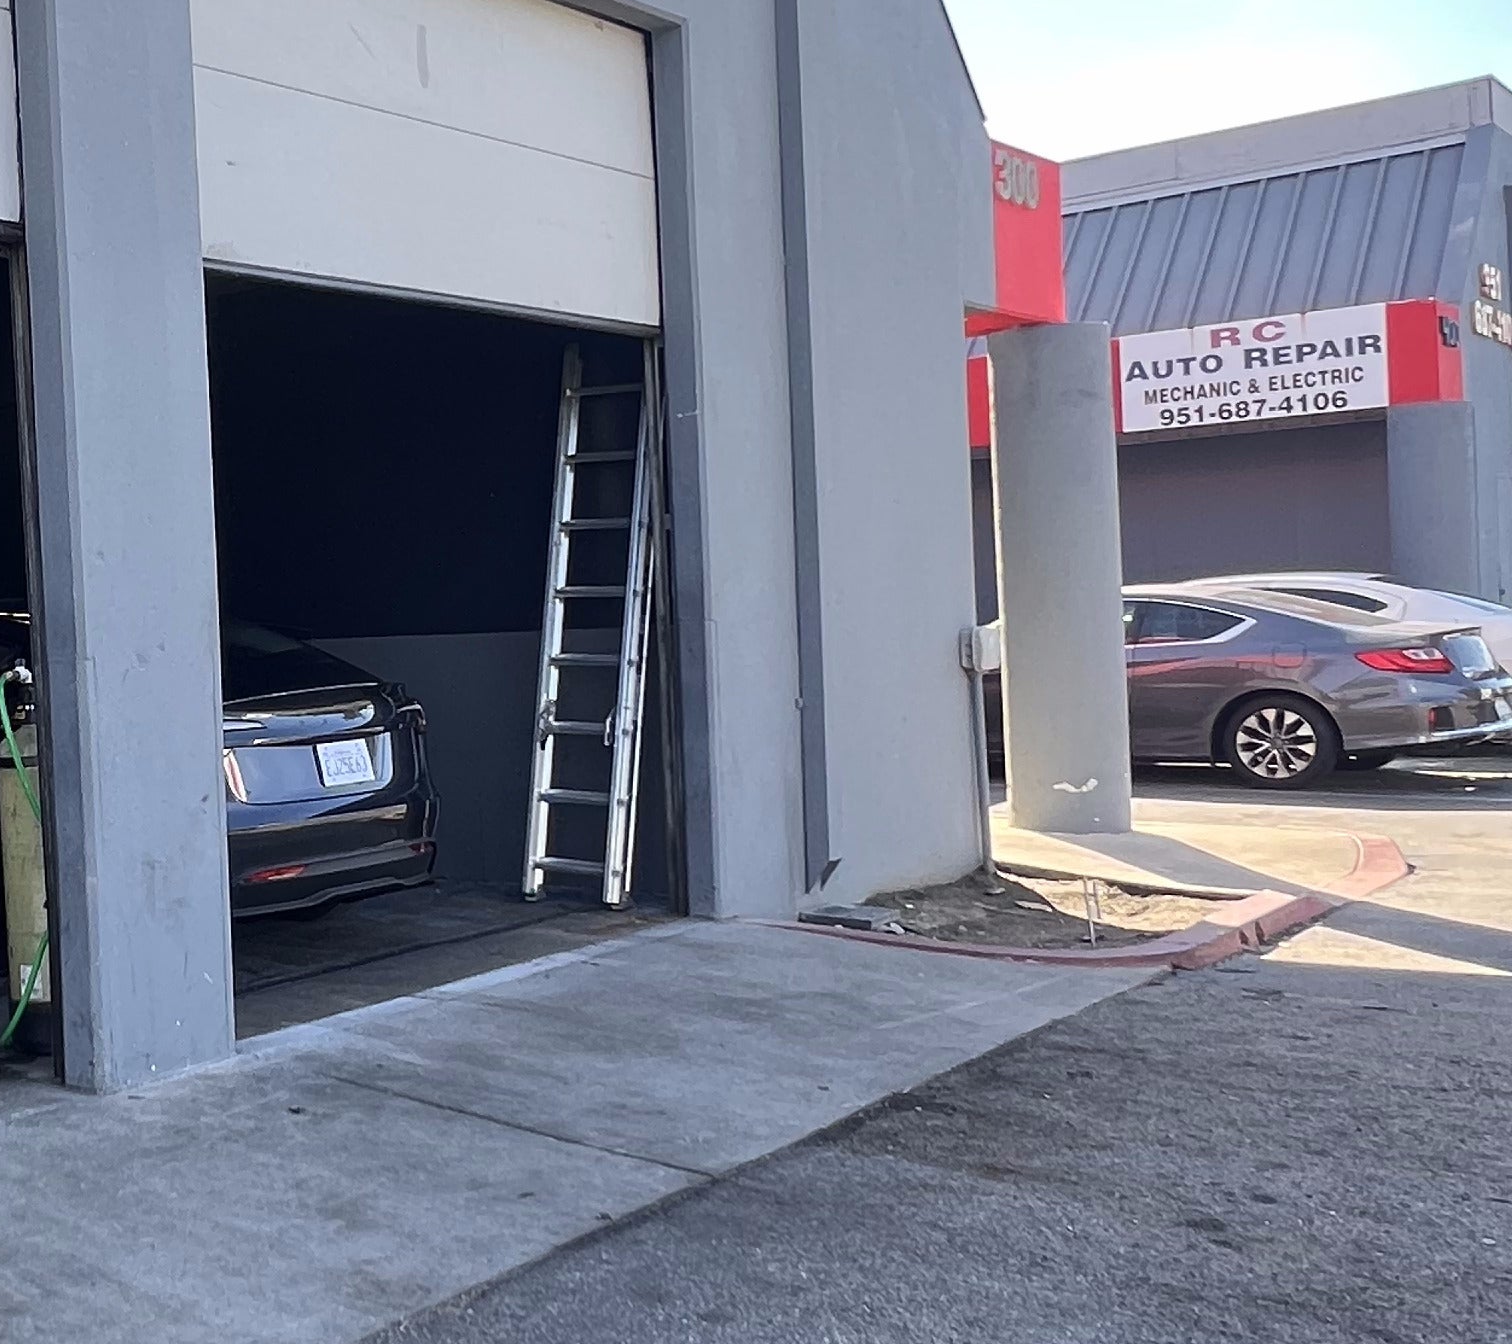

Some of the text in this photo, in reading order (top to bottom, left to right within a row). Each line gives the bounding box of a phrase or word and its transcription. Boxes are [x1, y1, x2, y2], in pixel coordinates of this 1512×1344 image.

[994, 149, 1040, 209] 300
[1125, 334, 1382, 382] AUTO REPAIR
[1144, 366, 1364, 405] MECHANIC & ELECTRIC
[1160, 390, 1348, 426] 951-687-4106
